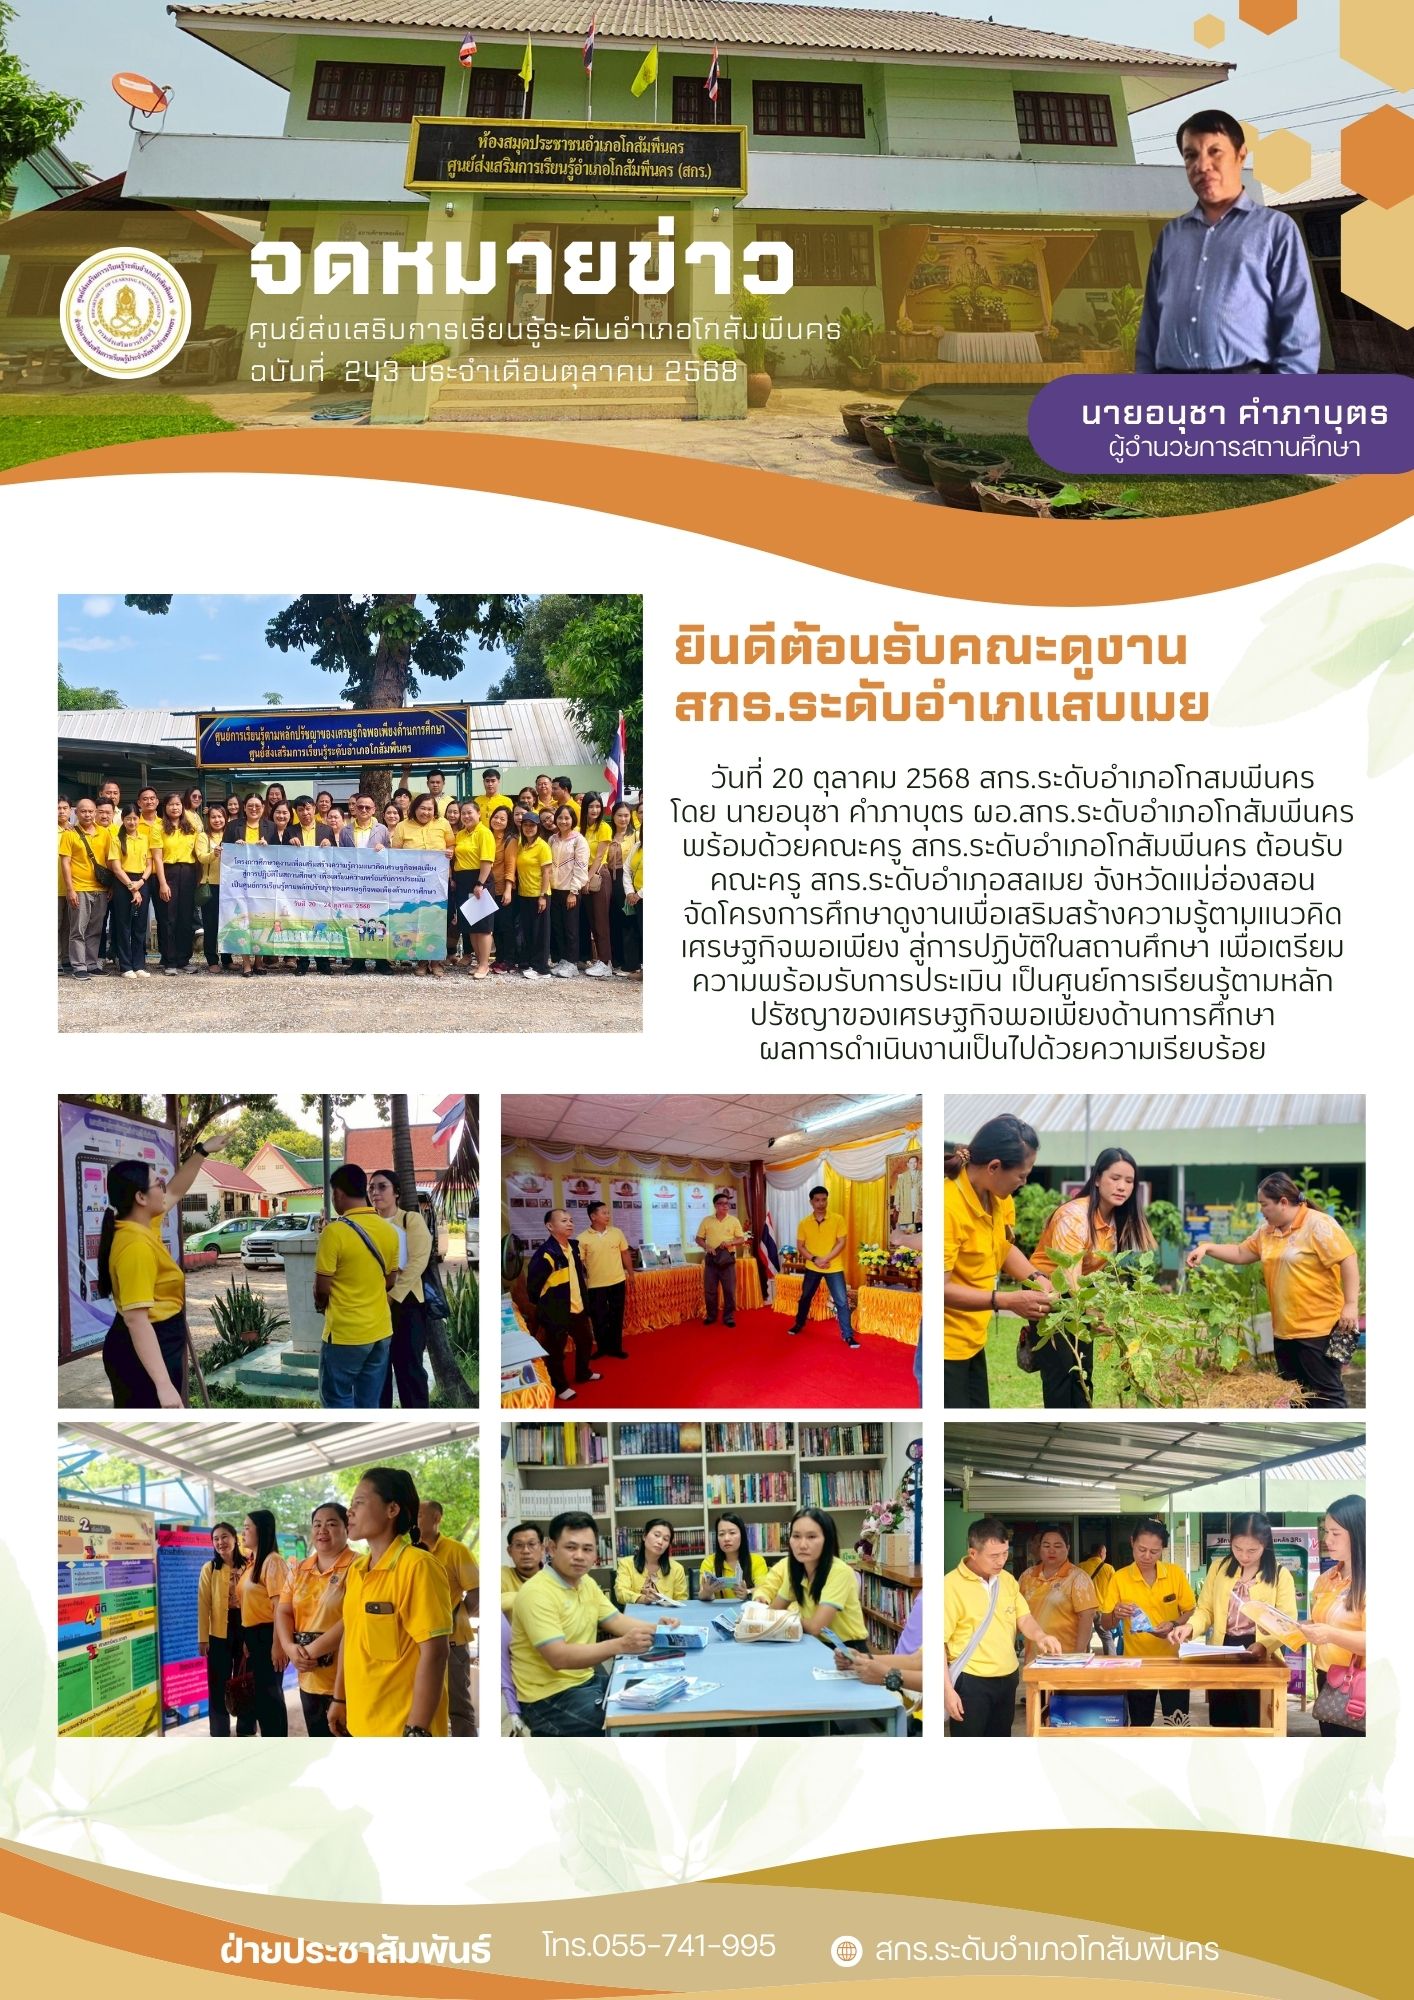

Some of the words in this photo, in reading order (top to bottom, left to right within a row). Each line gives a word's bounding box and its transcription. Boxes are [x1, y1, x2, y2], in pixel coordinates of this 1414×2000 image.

[478, 130, 684, 155] ห้องสมุดประชาชนอำเภอโกสัมพีนคร
[447, 154, 674, 181] ศูนย์ส่งเสริมการเรียนรู้อำเภอโกสัมพีนคร
[678, 162, 712, 180] (สกร.)
[85, 1608, 96, 1625] 4
